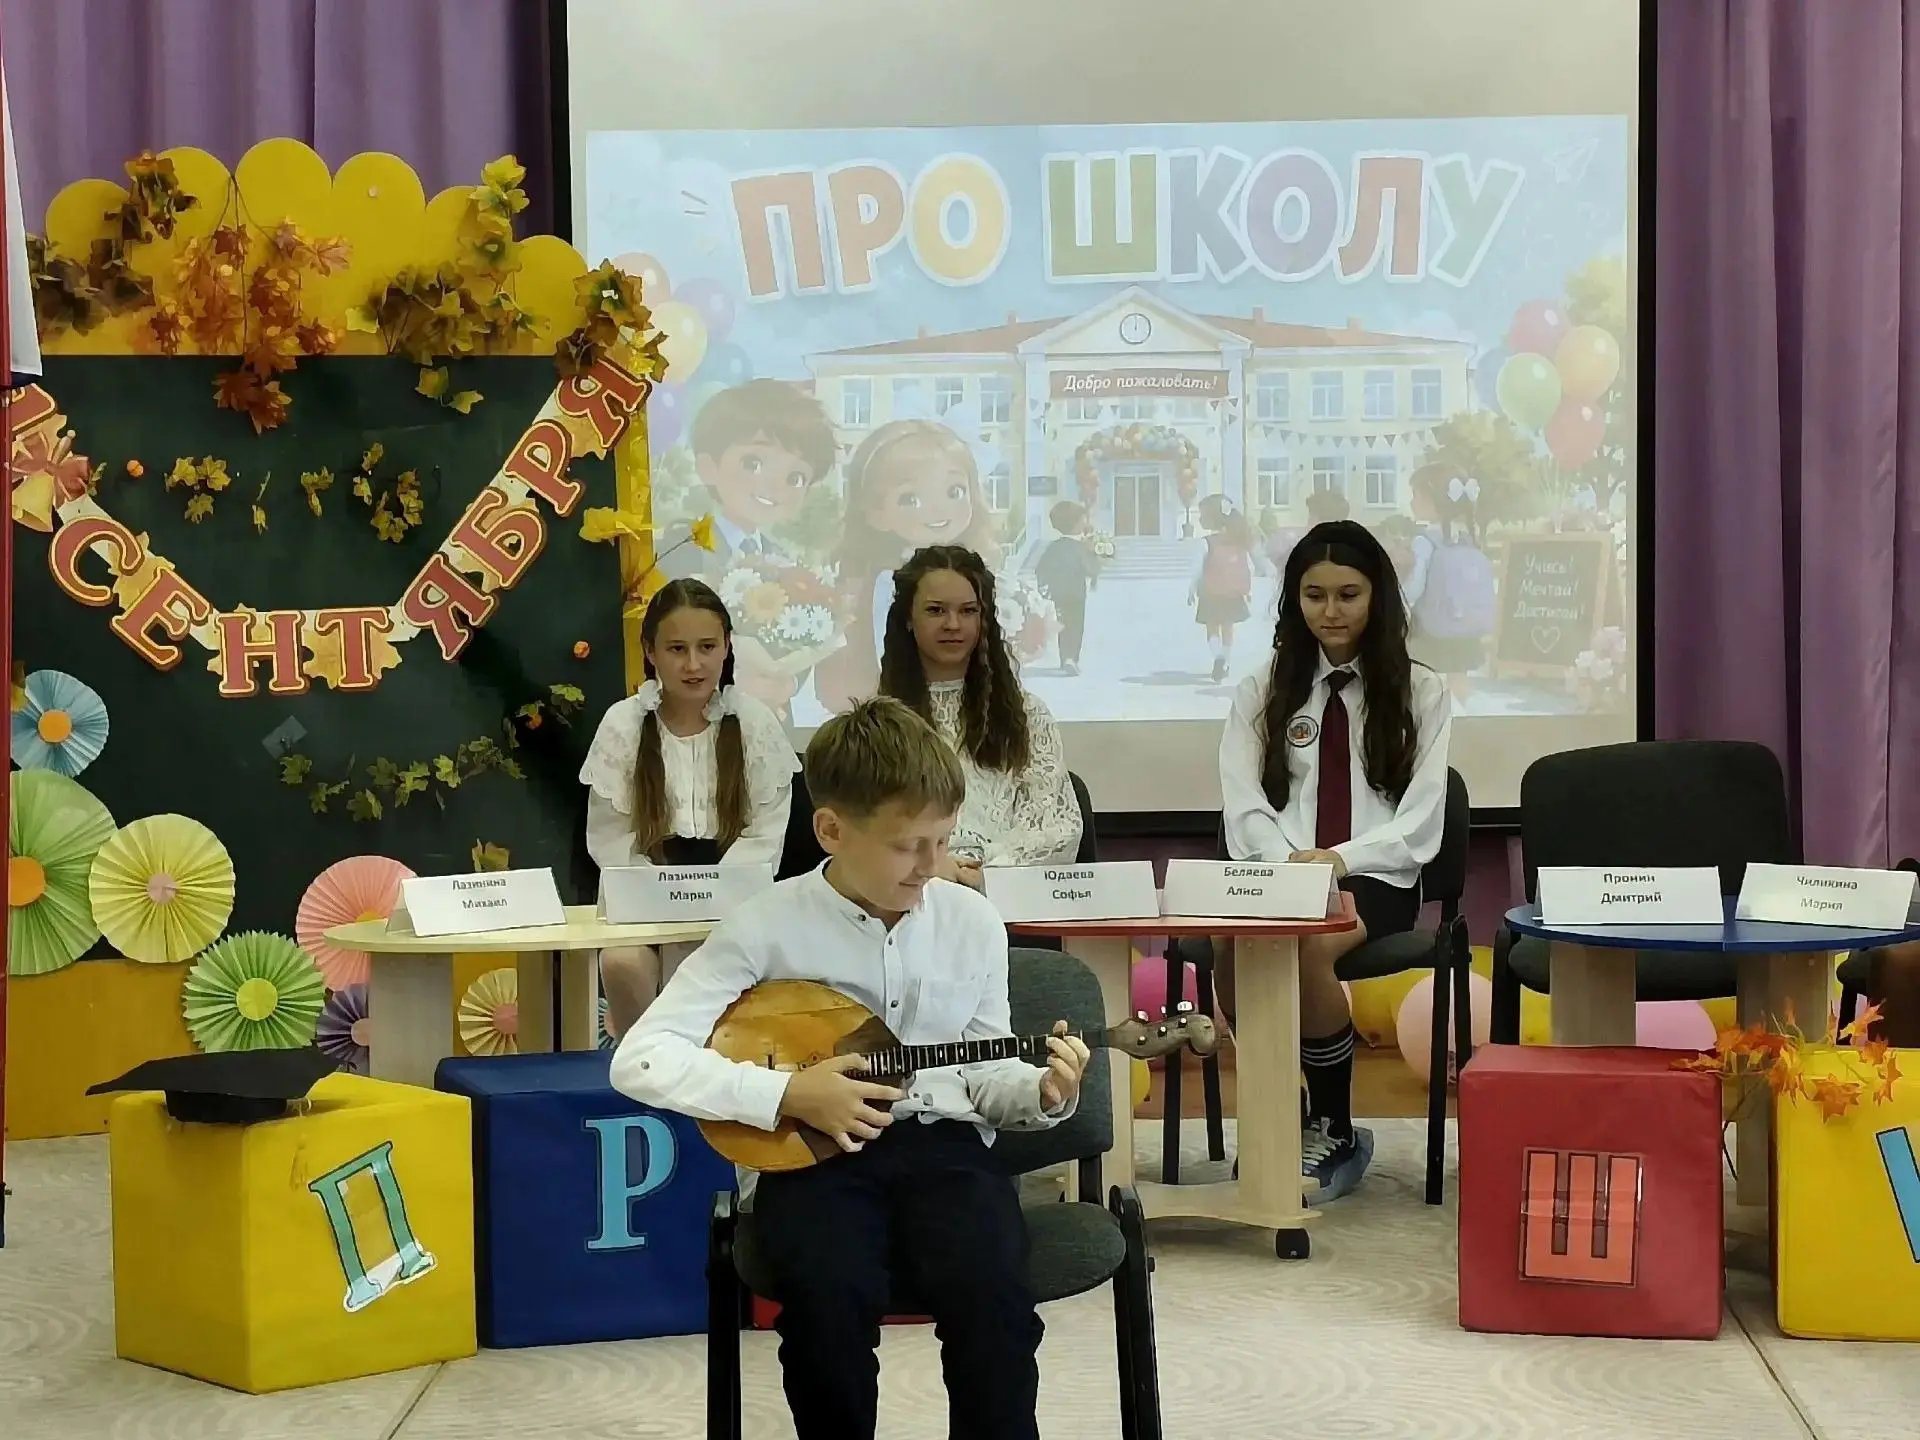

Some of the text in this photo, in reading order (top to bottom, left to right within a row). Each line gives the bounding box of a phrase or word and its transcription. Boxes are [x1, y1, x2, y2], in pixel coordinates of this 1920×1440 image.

[730, 145, 1526, 302] ПРО ШКОЛУ
[1063, 372, 1218, 394] Добро пожаловать!
[48, 357, 652, 698] СЕНТЯБРЯ
[1044, 870, 1095, 882] Юдаева
[1223, 865, 1275, 877] Беляева
[1603, 872, 1656, 885] Пронин
[669, 890, 713, 902] Мария
[1051, 888, 1092, 901] Софья
[1226, 885, 1264, 896] Алиса
[1600, 891, 1663, 904] Дмитрий
[1800, 898, 1844, 912] Мария
[582, 1115, 678, 1253] Р
[1520, 1148, 1643, 1287] Ш
[309, 1141, 438, 1312] П
